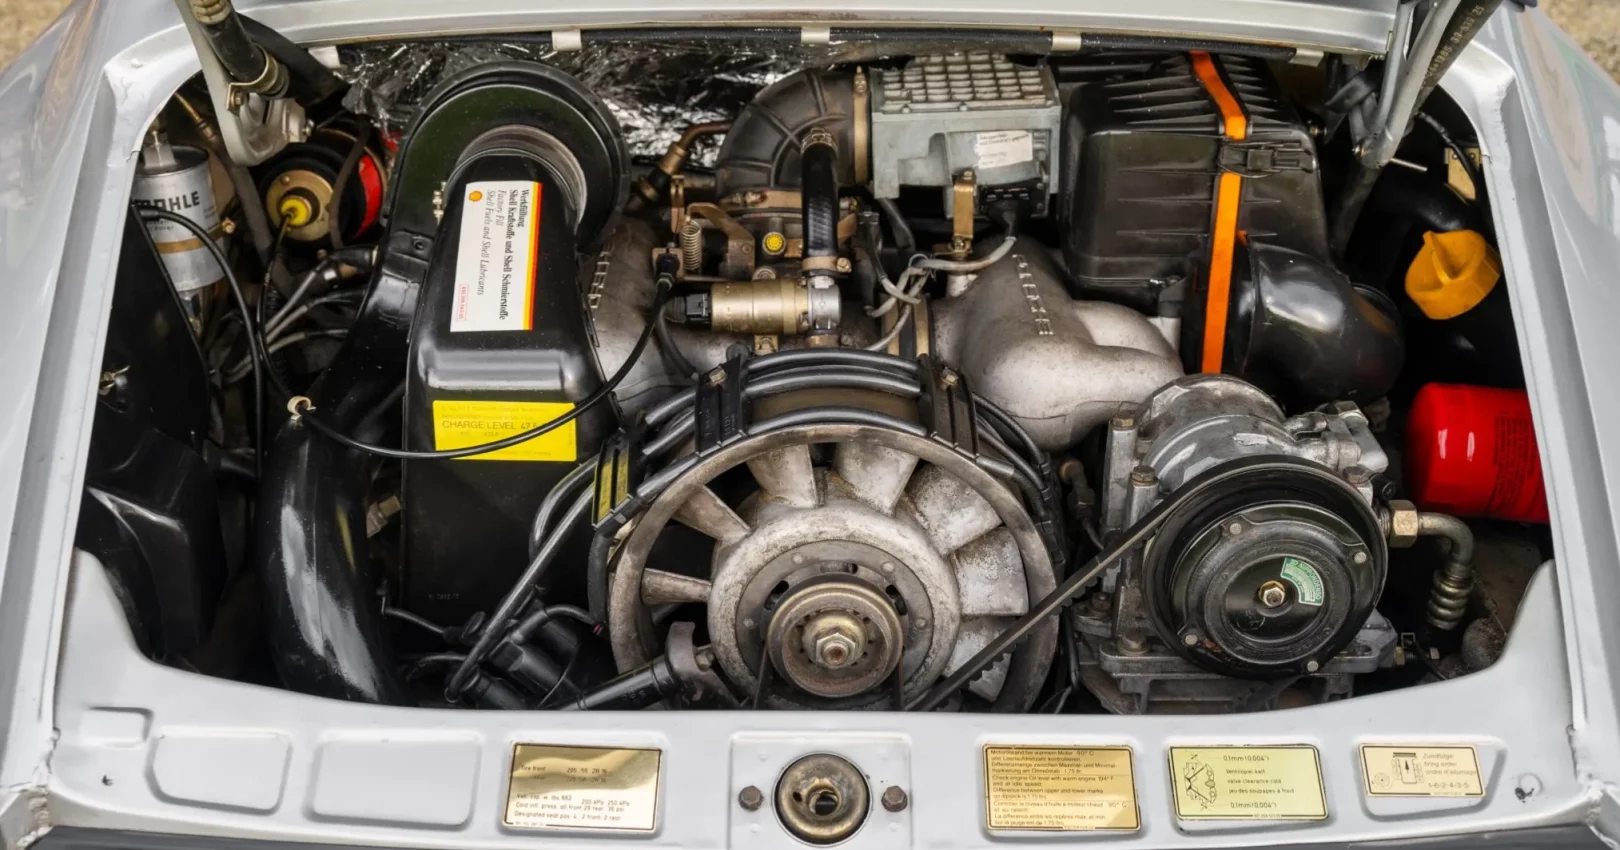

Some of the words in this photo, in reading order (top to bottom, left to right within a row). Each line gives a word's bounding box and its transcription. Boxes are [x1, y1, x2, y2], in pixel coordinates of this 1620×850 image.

[486, 190, 496, 206] Shell
[496, 189, 506, 214] Factory
[508, 189, 518, 206] Shell
[484, 207, 495, 225] Fuels
[496, 214, 504, 226] Fill
[506, 207, 517, 240] Kraftstoffe
[482, 226, 492, 240] and
[481, 240, 491, 258] Shell
[504, 240, 514, 254] und
[504, 255, 514, 272] Shell
[477, 259, 490, 296] Lubricants
[499, 274, 512, 320] Schmierstoffe
[442, 420, 484, 430] CHARGE
[486, 422, 516, 430] LEVEL
[1299, 561, 1322, 600] NIPPONDENSO
